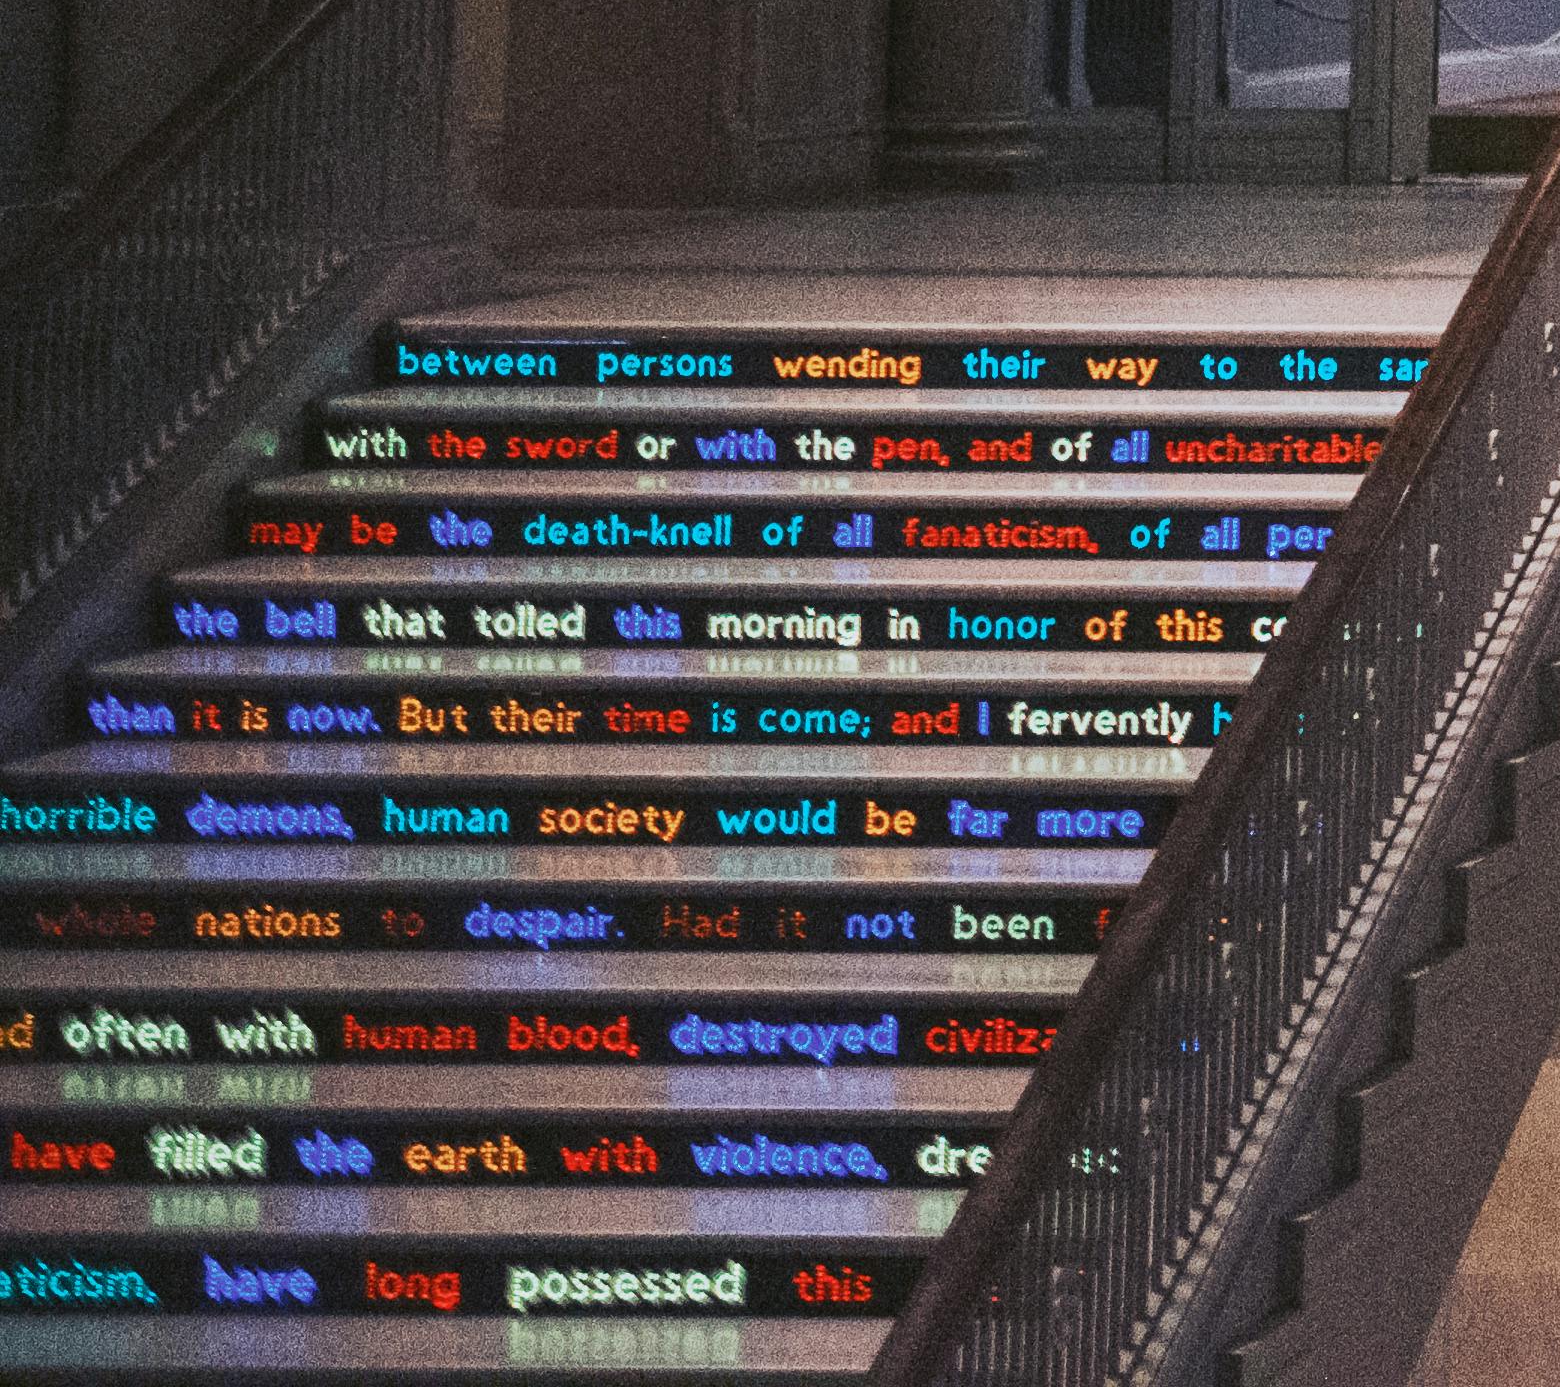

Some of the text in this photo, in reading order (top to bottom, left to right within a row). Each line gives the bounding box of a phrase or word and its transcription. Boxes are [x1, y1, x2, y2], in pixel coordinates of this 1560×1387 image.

[399, 347, 1338, 386] between persons wending their way to the
[327, 430, 1384, 469] with the sword or with the pen, and of all uncharitable
[252, 511, 1240, 554] may be the death-knell of all fanaticism, of all
[174, 601, 1223, 650] the bell that tolled this morning in honor of this
[194, 695, 1192, 743] it is now. But their time is come; and fervently
[0, 797, 1144, 842] horrible human society would be more
[196, 903, 1054, 950] nations despair. Had not been
[63, 1011, 899, 1067] often with human blood, destroyed
[12, 1128, 888, 1180] have filled earth with violence,
[367, 1260, 871, 1312] long possessed this
